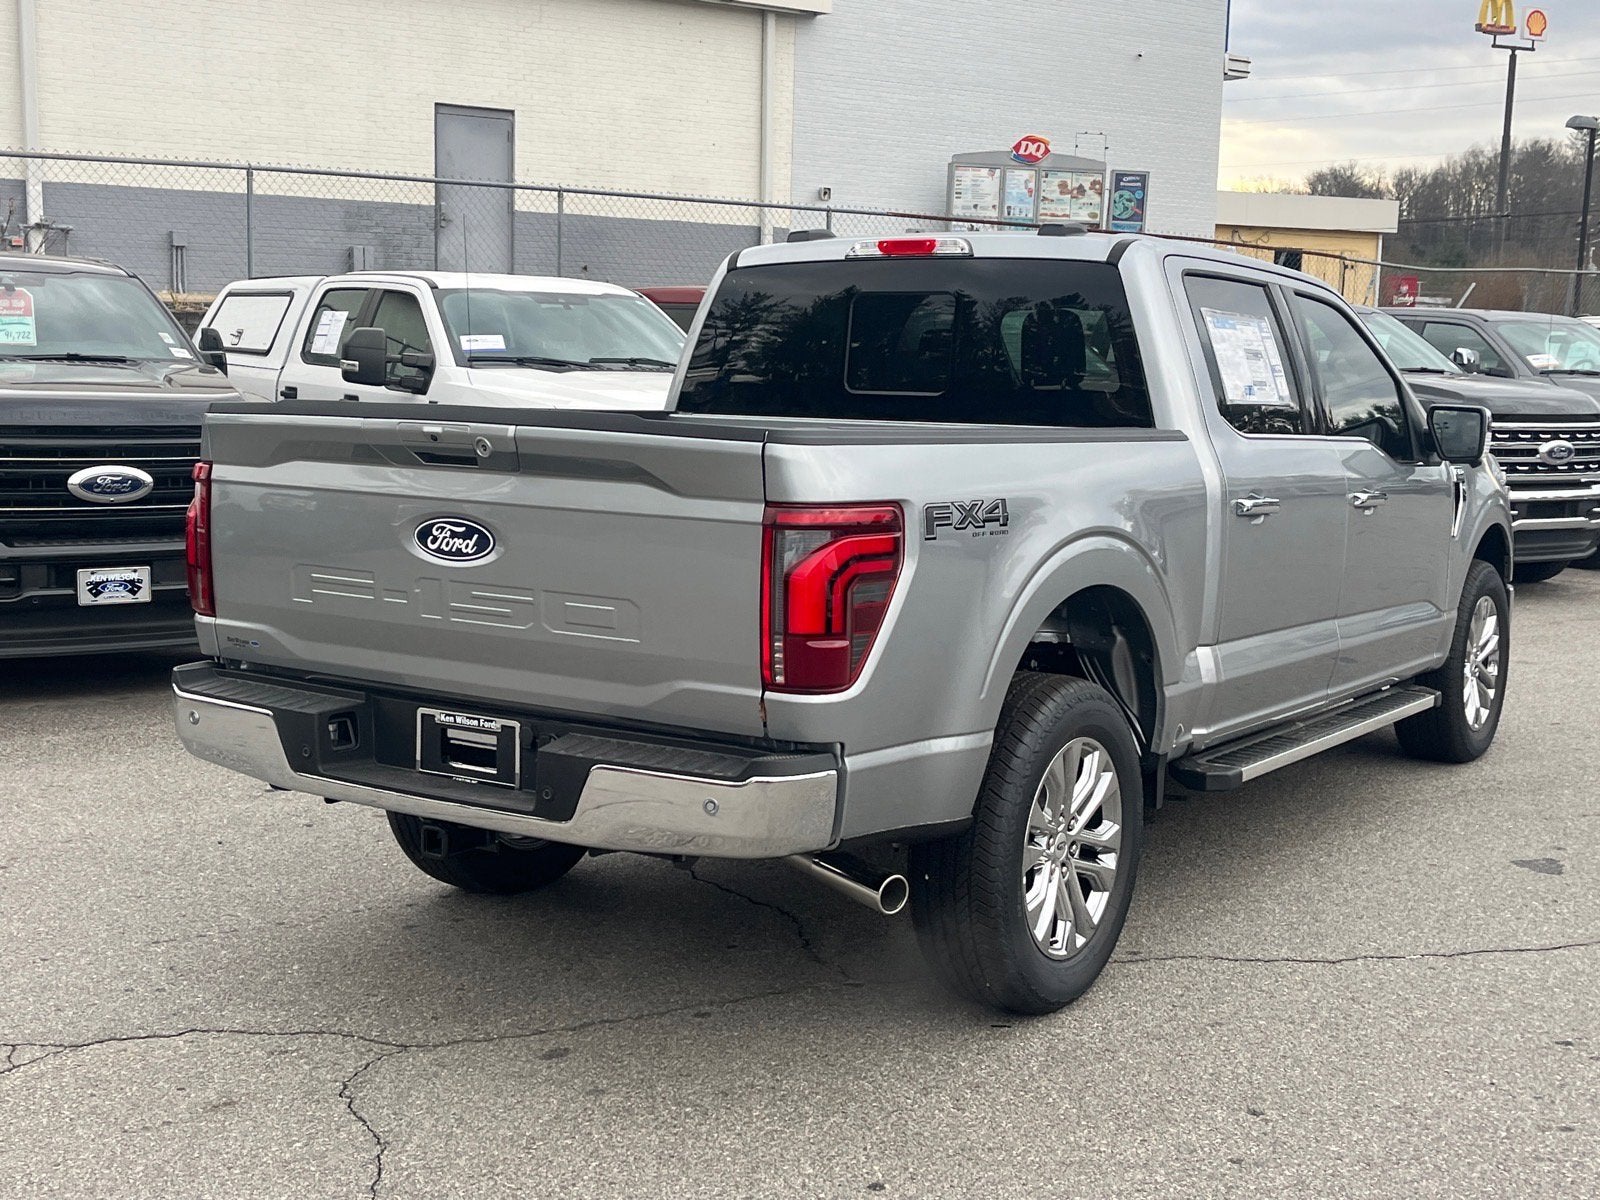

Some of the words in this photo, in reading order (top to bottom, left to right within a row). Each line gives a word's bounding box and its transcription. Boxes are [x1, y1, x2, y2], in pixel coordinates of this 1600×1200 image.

[1018, 140, 1046, 158] DQ
[93, 475, 132, 493] Ford
[923, 498, 1009, 541] FX4
[427, 522, 479, 555] Ford
[989, 529, 1009, 537] ROAD
[90, 573, 107, 583] KEN
[107, 571, 139, 582] WILSON
[104, 583, 125, 592] Ford
[291, 562, 642, 644] F-150
[440, 713, 455, 724] Ken
[455, 715, 479, 727] Wilson
[479, 718, 497, 729] Ford
